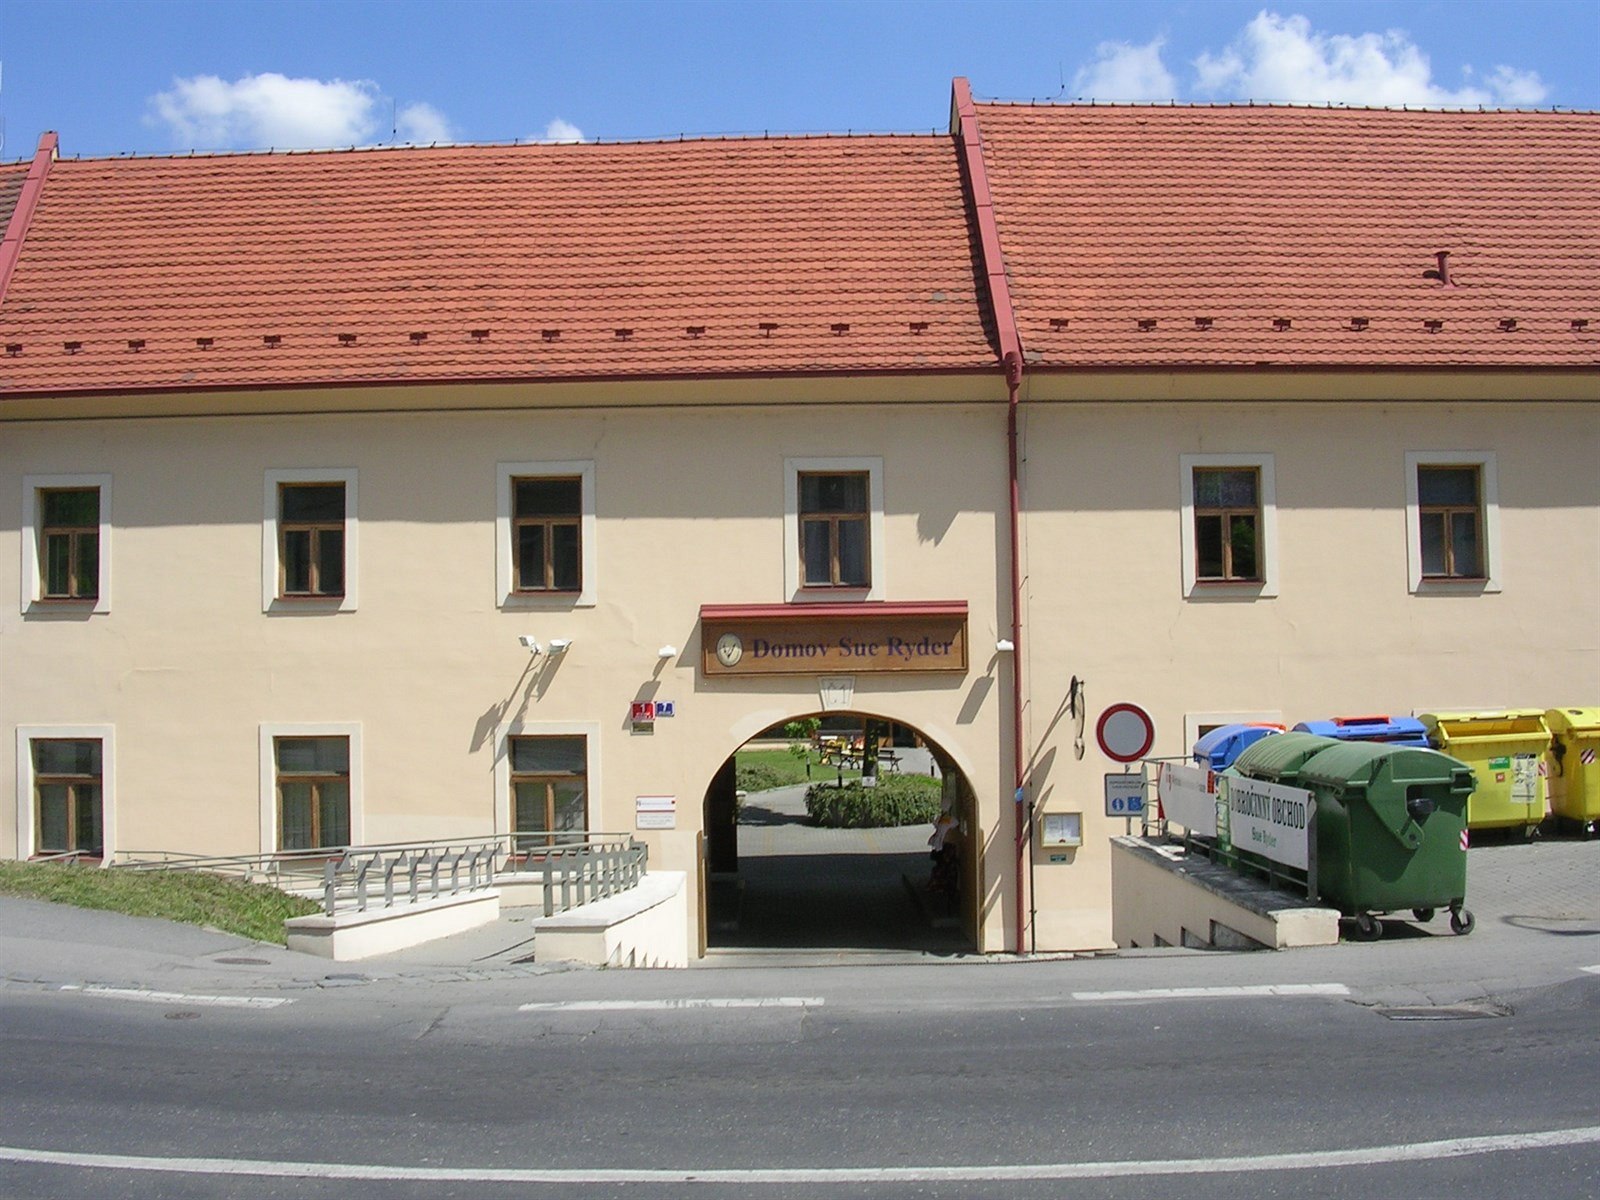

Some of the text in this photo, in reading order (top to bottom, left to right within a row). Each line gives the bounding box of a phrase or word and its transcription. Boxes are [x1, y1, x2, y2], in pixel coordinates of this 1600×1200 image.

[752, 636, 953, 662] Domov Sue Ryder
[1272, 797, 1306, 830] OBCHOD
